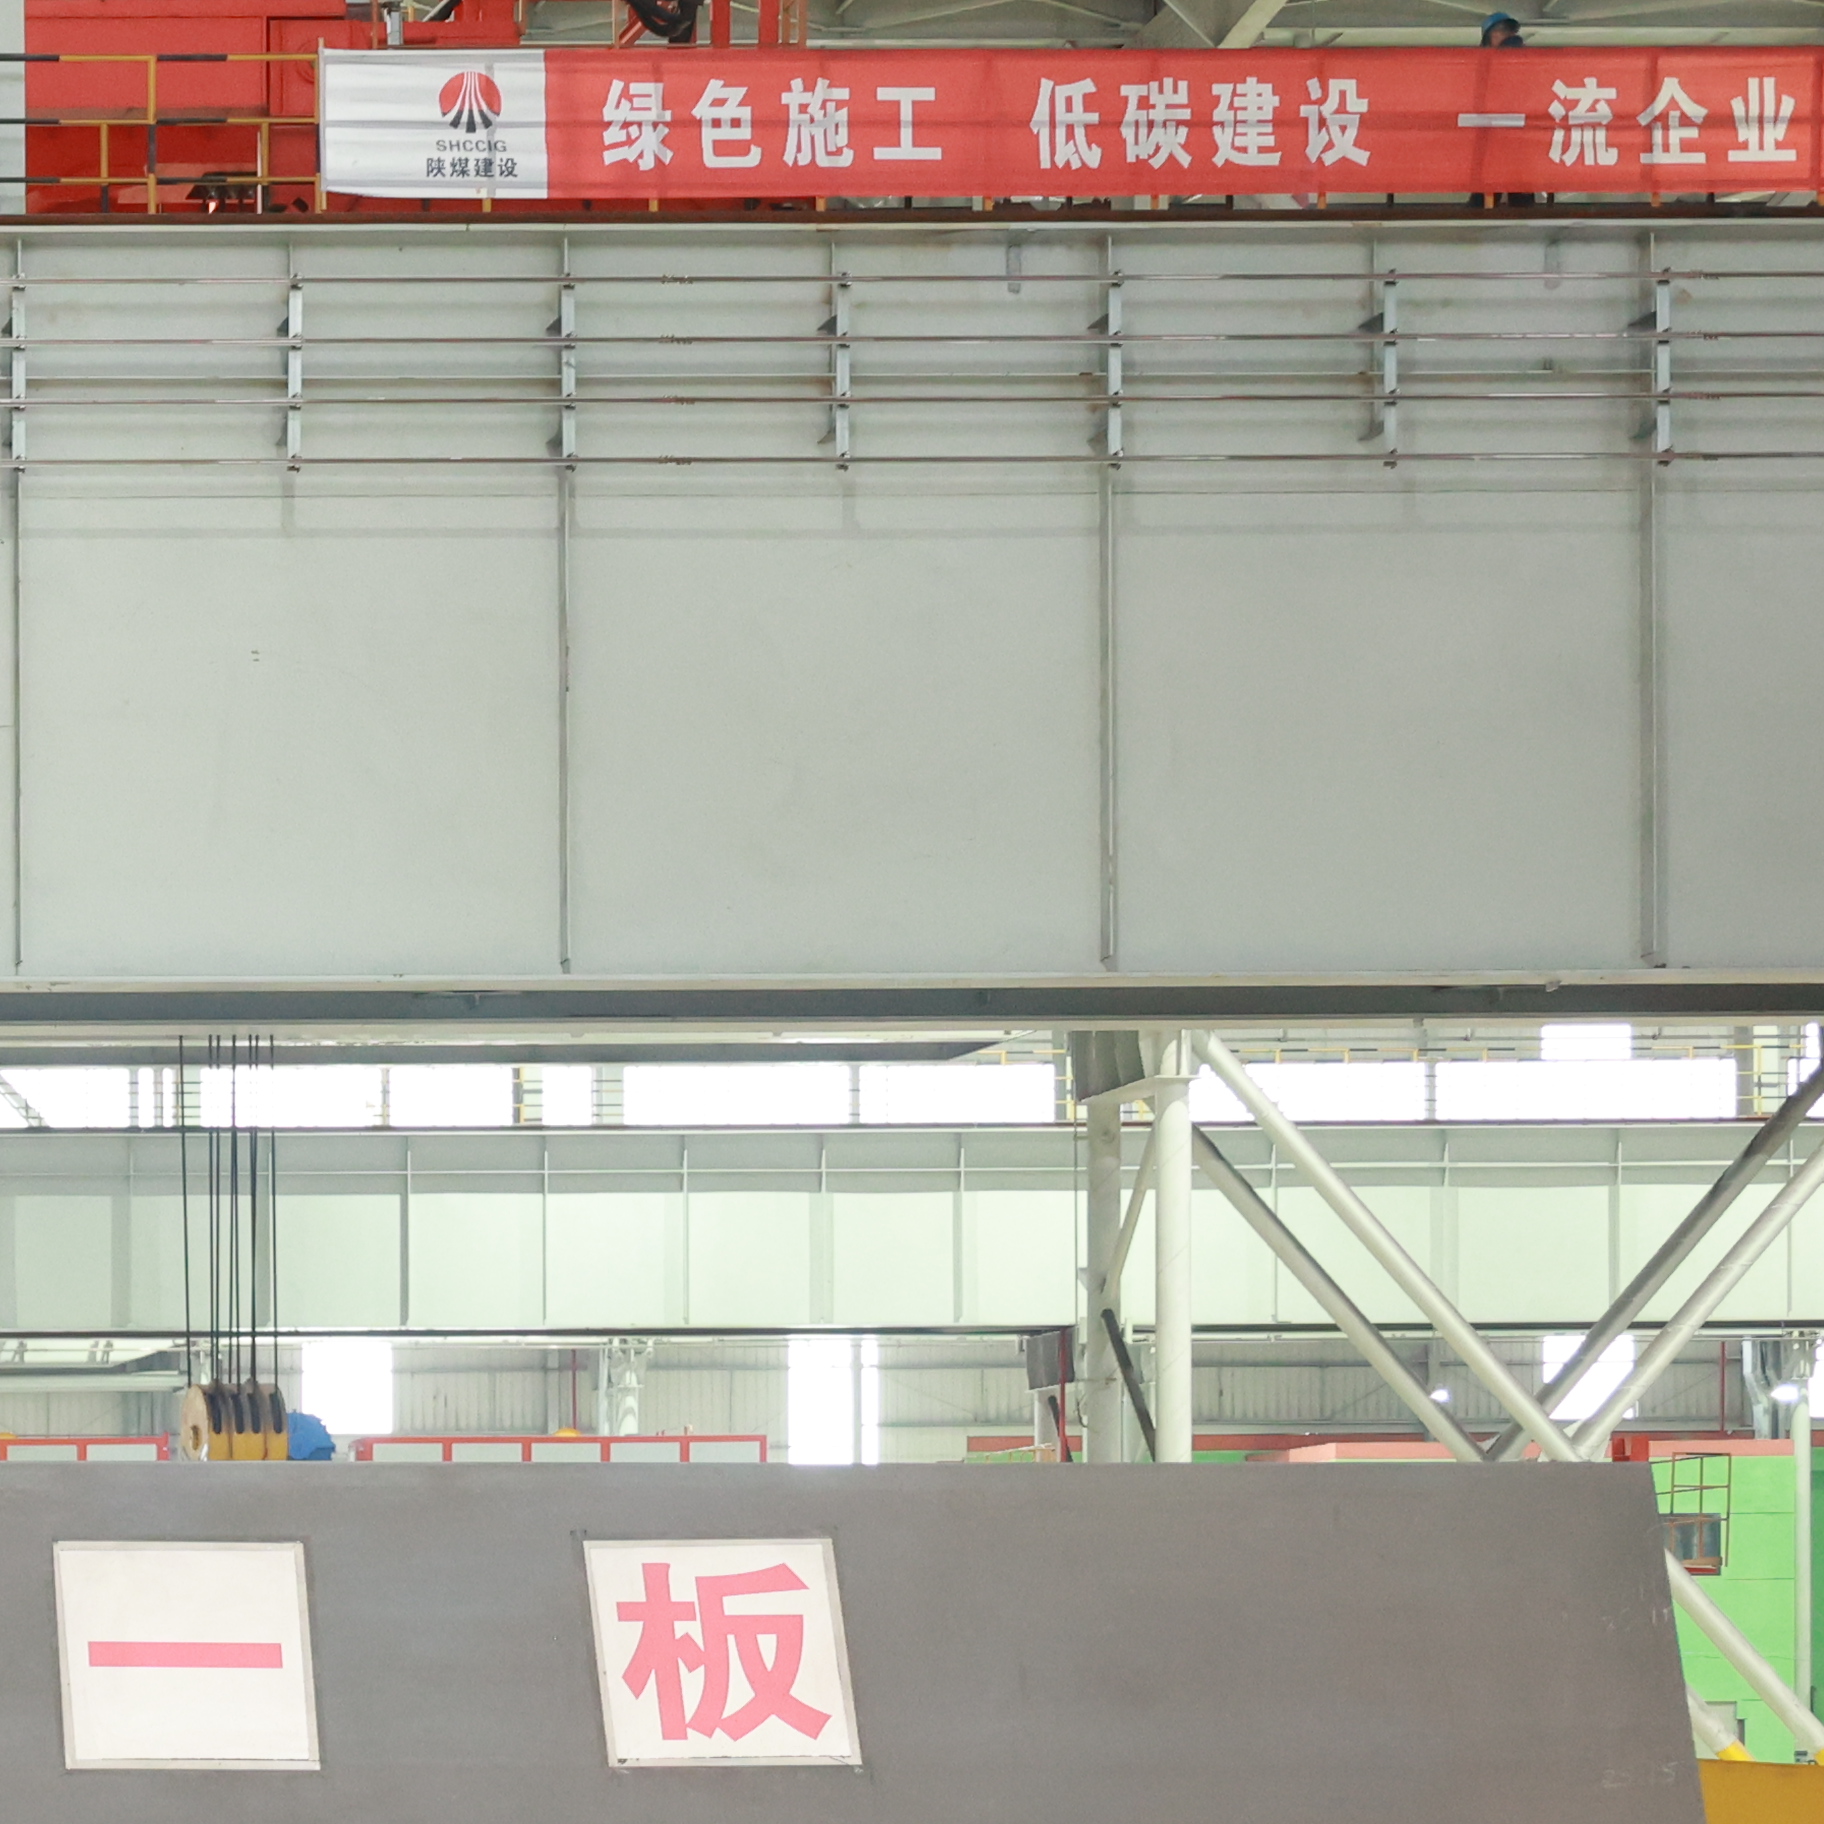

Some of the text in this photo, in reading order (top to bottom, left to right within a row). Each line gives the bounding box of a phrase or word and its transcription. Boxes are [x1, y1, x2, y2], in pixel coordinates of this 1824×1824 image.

[602, 77, 1797, 170] 绿色施工 低碳建设 一流企业
[436, 139, 507, 152] SHCCIG
[426, 157, 518, 178] 陕煤建设
